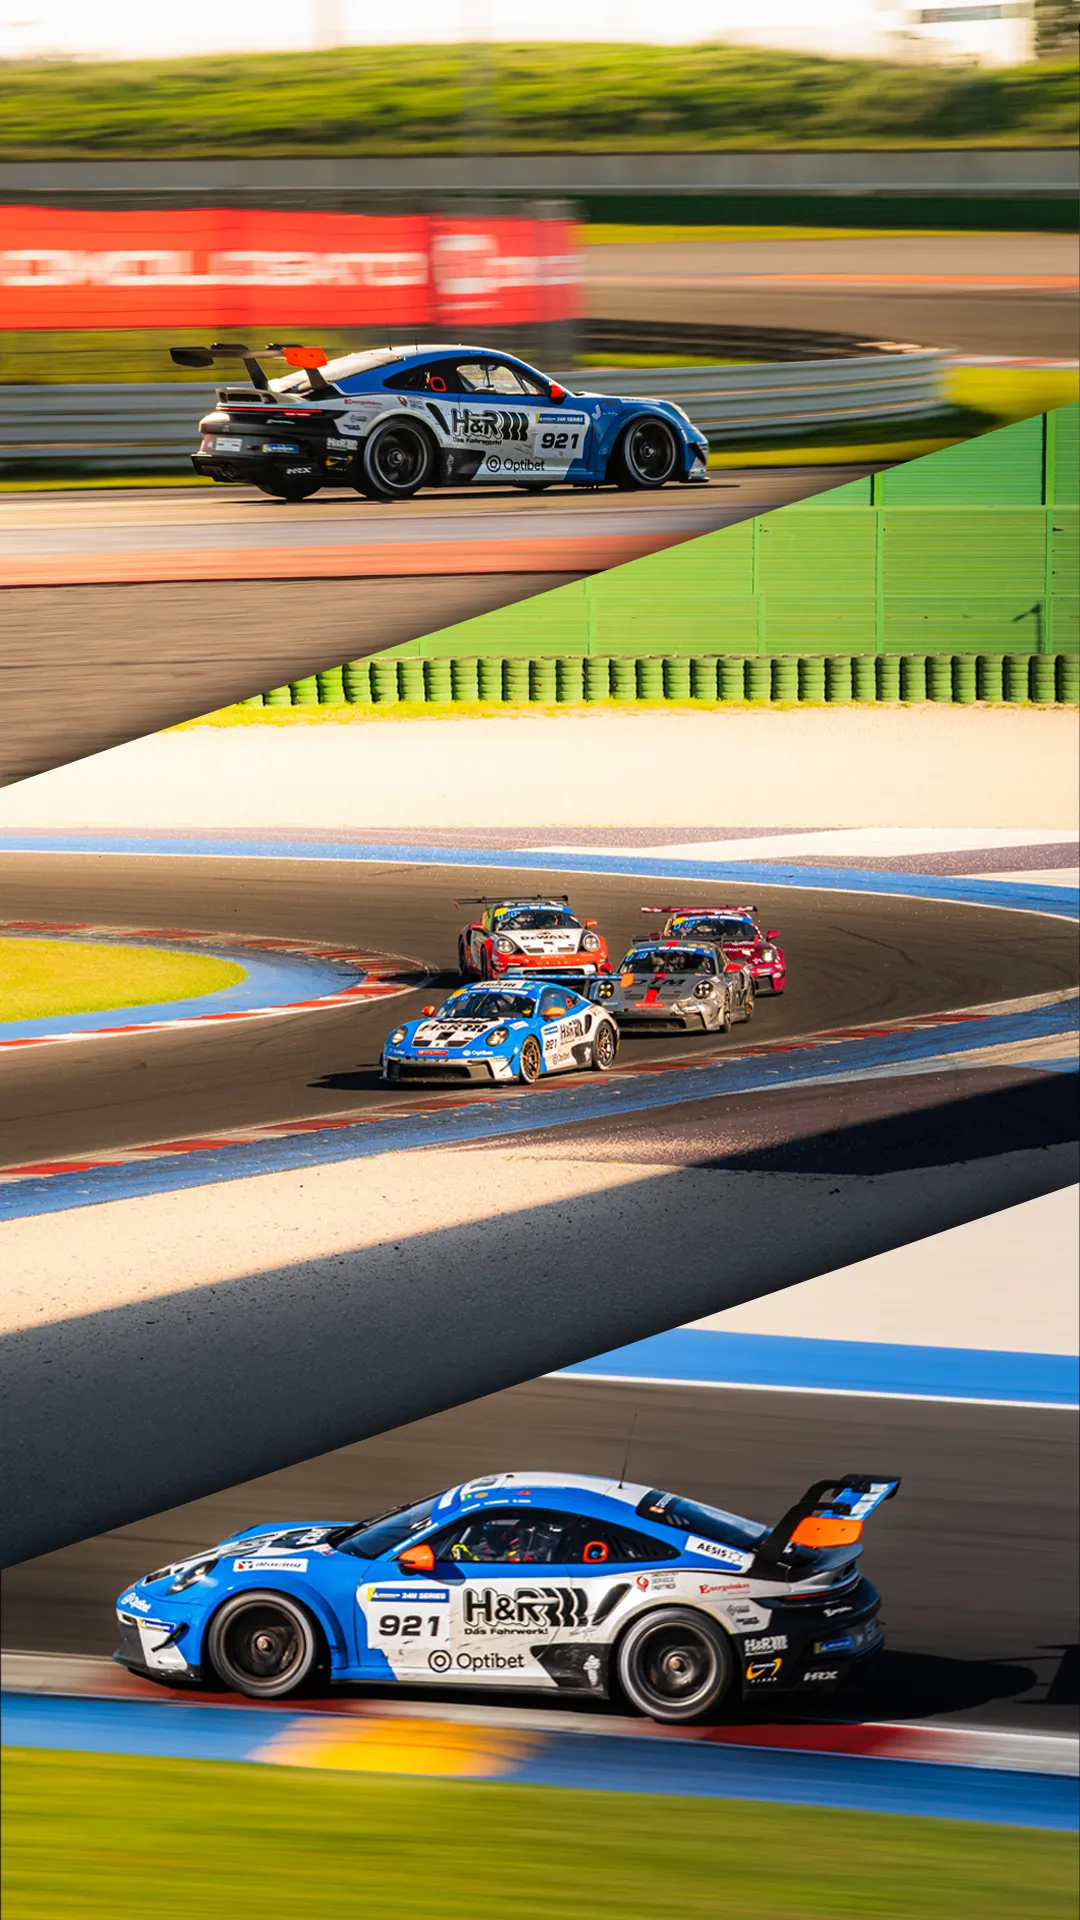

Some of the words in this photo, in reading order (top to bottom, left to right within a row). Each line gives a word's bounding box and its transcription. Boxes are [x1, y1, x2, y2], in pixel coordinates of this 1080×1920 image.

[451, 408, 504, 439] H&R
[541, 433, 580, 449] 921
[504, 457, 545, 472] Optibet
[545, 1038, 557, 1050] 921
[697, 1542, 727, 1558] AESIS
[419, 1592, 447, 1600] SERIES
[463, 1588, 549, 1628] H&R
[378, 1614, 440, 1637] 921
[490, 1627, 549, 1636] Fahrwerk!
[456, 1651, 525, 1672] Optibet
